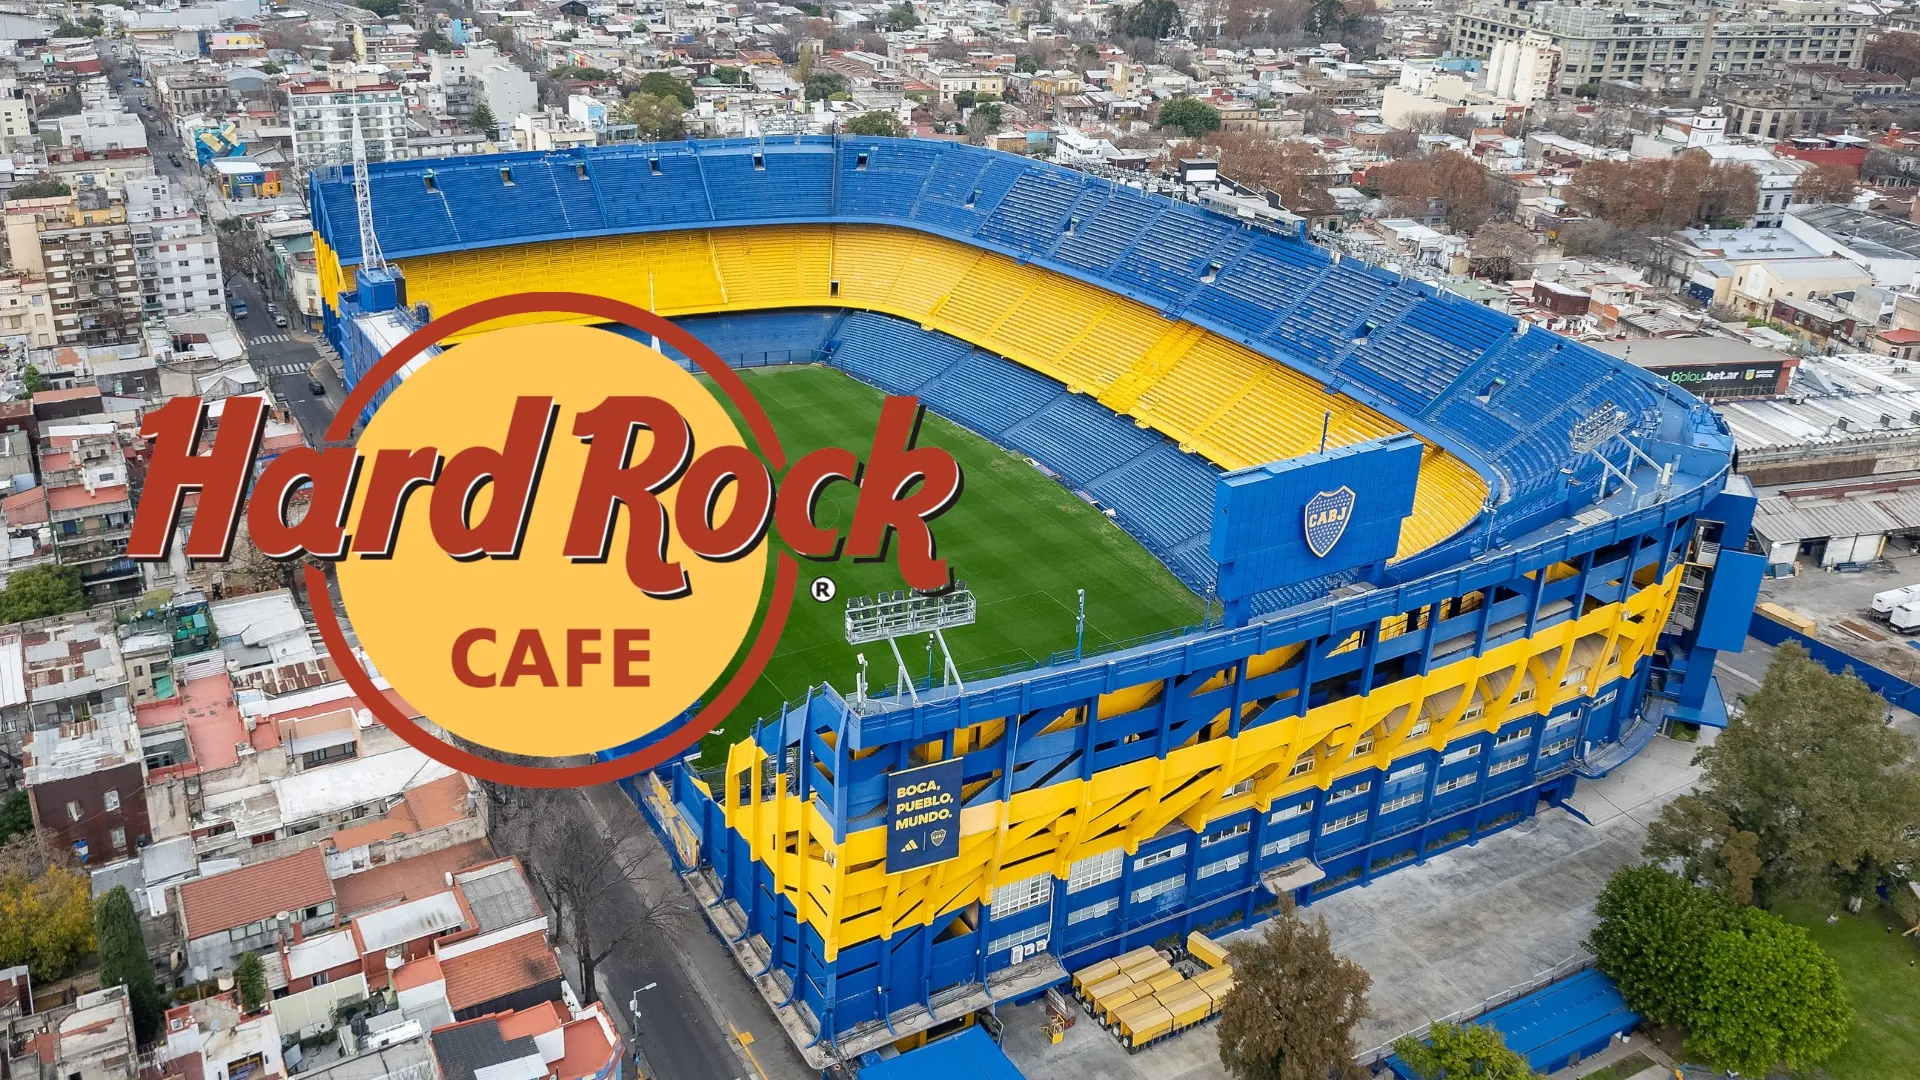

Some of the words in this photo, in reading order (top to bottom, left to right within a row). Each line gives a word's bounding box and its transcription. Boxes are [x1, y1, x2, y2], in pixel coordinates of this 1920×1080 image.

[1671, 370, 1740, 384] bplay.bet.ar
[1308, 506, 1347, 528] CABJ
[896, 780, 940, 799] BOCA,
[896, 792, 953, 815] PUEBLO,
[896, 809, 952, 831] MUNDO.
